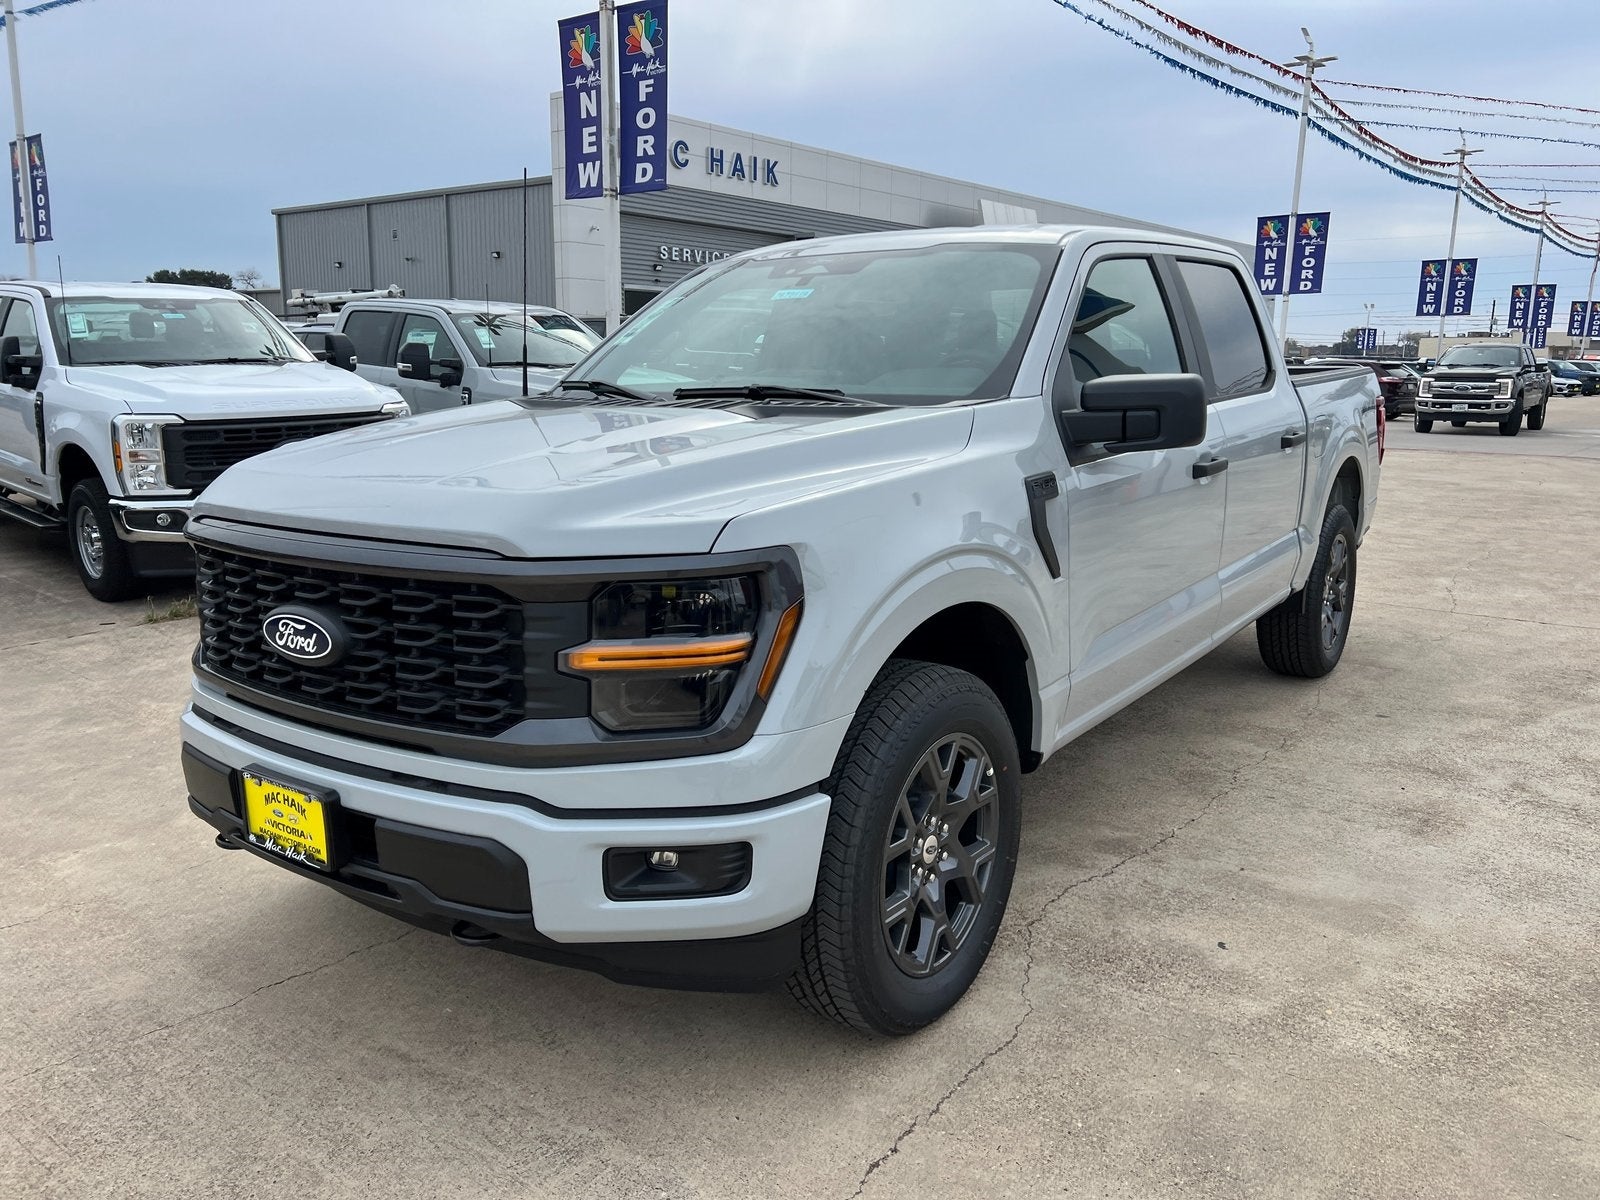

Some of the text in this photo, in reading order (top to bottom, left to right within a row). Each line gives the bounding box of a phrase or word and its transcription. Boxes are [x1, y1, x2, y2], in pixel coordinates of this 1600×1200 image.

[578, 90, 600, 188] NEW
[635, 79, 656, 183] FORD
[707, 147, 779, 186] HAIK
[36, 178, 47, 237] FORD
[1260, 248, 1277, 291] NEW
[1299, 246, 1316, 291] FORD
[1422, 282, 1436, 314] NEW
[1453, 281, 1466, 314] FORD
[1513, 302, 1524, 326] NEW
[1537, 301, 1548, 326] FORD
[1571, 315, 1582, 335] NEW
[276, 619, 317, 653] Ford
[264, 792, 281, 806] MAC
[282, 793, 307, 820] HAIK
[264, 838, 283, 852] Mac
